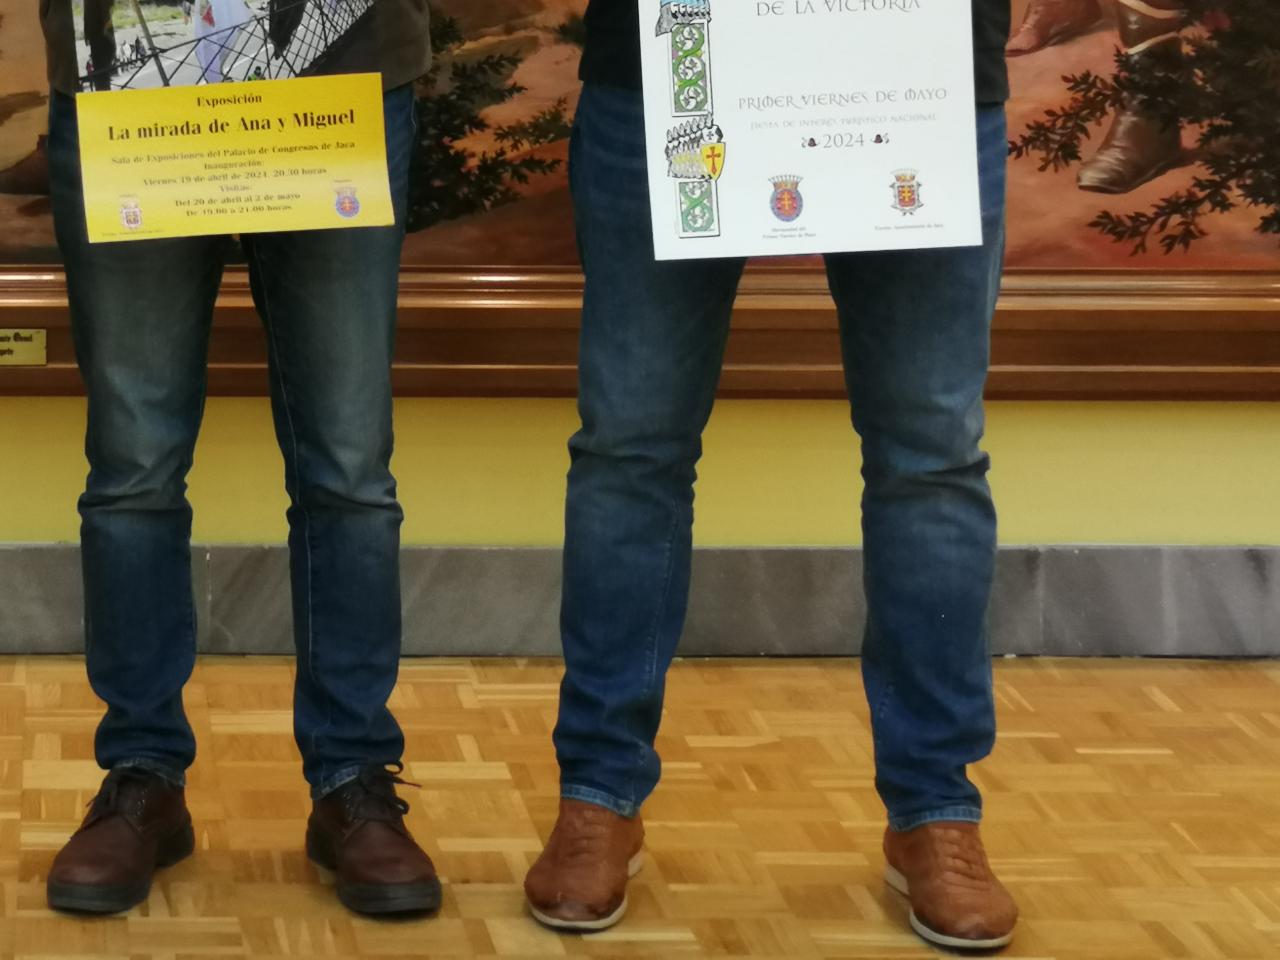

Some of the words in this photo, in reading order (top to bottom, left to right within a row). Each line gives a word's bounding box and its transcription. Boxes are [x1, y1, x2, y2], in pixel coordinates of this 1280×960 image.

[756, 1, 785, 16] DE
[795, 0, 816, 14] LA
[196, 93, 262, 108] Exposición
[738, 95, 803, 111] PRIMER
[801, 92, 869, 107] VIERNES
[875, 90, 898, 103] DE
[904, 88, 948, 101] MAYO
[108, 126, 130, 140] La
[137, 120, 202, 139] mirada
[208, 118, 230, 134] de
[238, 116, 271, 131] Ana
[277, 117, 287, 132] y
[293, 109, 355, 128] Miguel
[258, 146, 269, 154] de
[321, 142, 331, 150] de
[334, 141, 355, 149] Jaca
[823, 133, 865, 149] 2024
